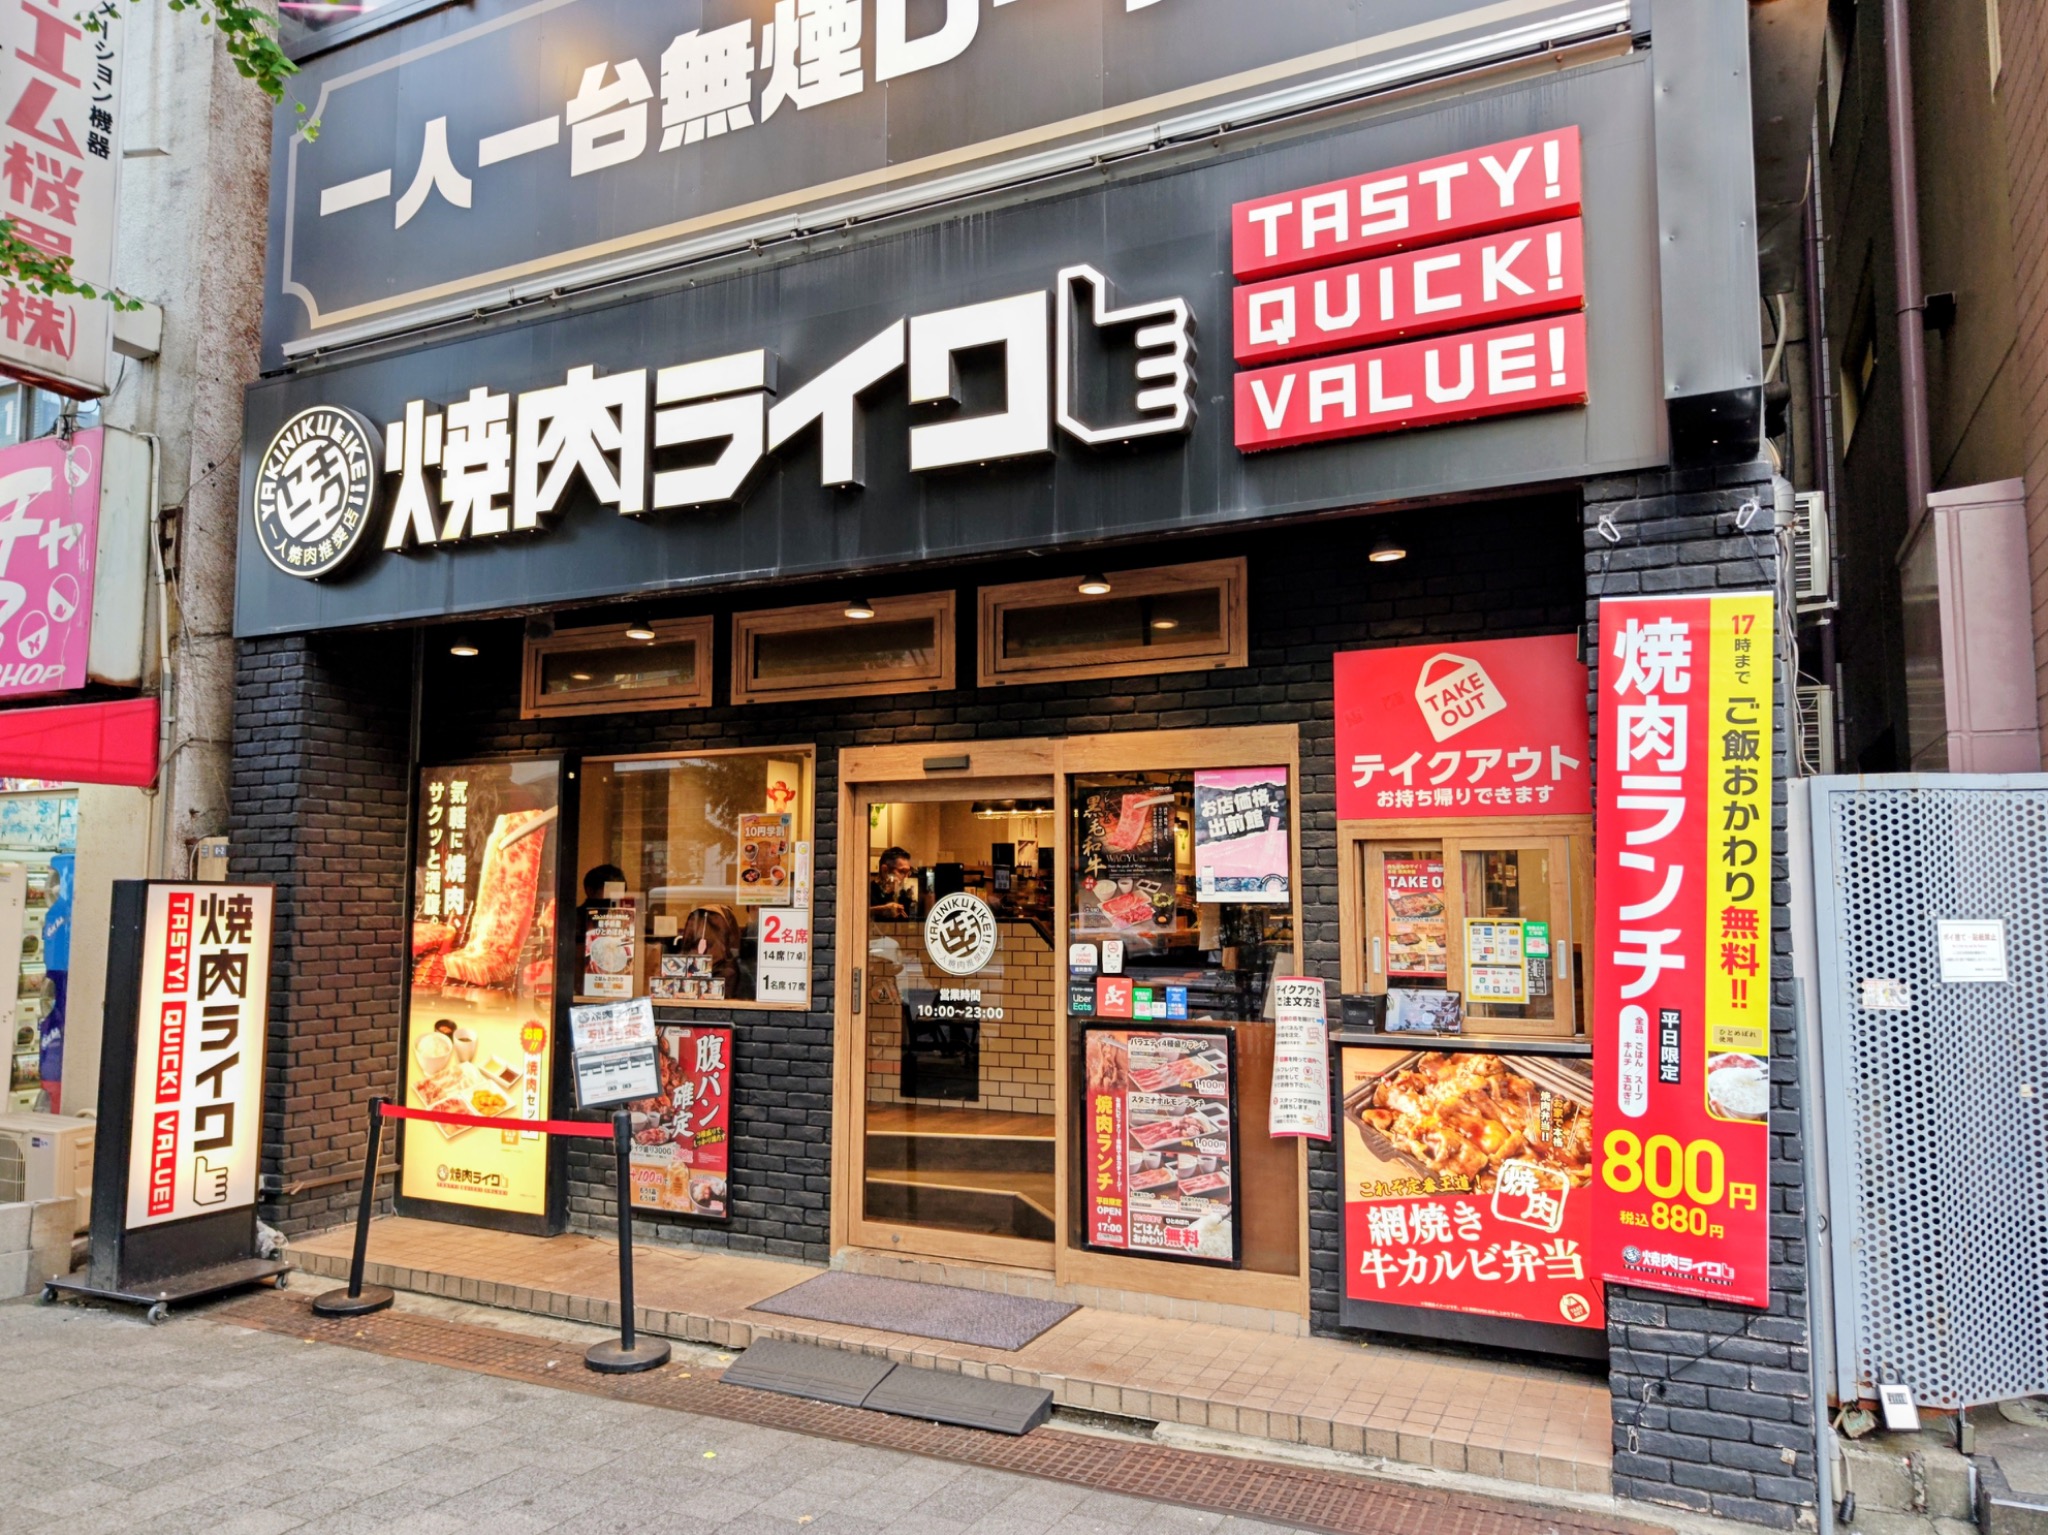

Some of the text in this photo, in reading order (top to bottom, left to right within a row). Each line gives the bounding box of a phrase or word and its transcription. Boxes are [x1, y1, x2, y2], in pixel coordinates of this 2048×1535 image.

[1248, 139, 1561, 258] TASTY!
[1248, 231, 1563, 346] QUICK!
[1250, 326, 1566, 431] VALUE!
[383, 289, 1050, 552] 焼肉ライク
[1731, 614, 1756, 685] 17時まで
[1424, 672, 1485, 713] TAKE
[1441, 692, 1487, 727] OUT
[1351, 745, 1580, 788] テイクアウト
[1200, 788, 1280, 817] お店価格で
[1376, 785, 1554, 808] お持ち帰りできます
[1612, 616, 1693, 1000] 焼肉ランチ
[1082, 795, 1107, 878] 黒毛和牛
[1208, 809, 1265, 838] 出前館
[1388, 876, 1428, 888] TAKE
[166, 897, 190, 990] TASTY!
[763, 915, 808, 944] 2名席
[763, 950, 785, 961] 14席
[763, 974, 806, 991] 1名席 17席
[1072, 994, 1092, 1003] Uber
[193, 893, 253, 1152] 焼肉ライク
[1072, 1003, 1092, 1011] Eats
[158, 1007, 183, 1097] QUICK!
[1660, 1011, 1680, 1082] 平日限定
[1719, 1029, 1757, 1038] ひとめぼれ
[695, 1034, 726, 1127] 腹パン
[672, 1082, 695, 1138] 確定
[151, 1114, 176, 1213] VALUE!
[1095, 1095, 1113, 1191] 焼肉ランチ
[449, 1167, 500, 1187] 焼肉ライク
[1359, 1175, 1483, 1198] これぞ定番王道！
[1602, 1129, 1757, 1211] 800円
[1096, 1206, 1122, 1216] OPEN
[1501, 1166, 1560, 1231] 焼肉
[1097, 1222, 1122, 1233] 17:00
[1164, 1226, 1199, 1248] 無料
[1366, 1201, 1483, 1247] 網焼き
[1619, 1202, 1724, 1239] 税込880円
[1360, 1238, 1585, 1289] 牛カルビ弁当
[1643, 1250, 1721, 1277] 焼肉ライク
